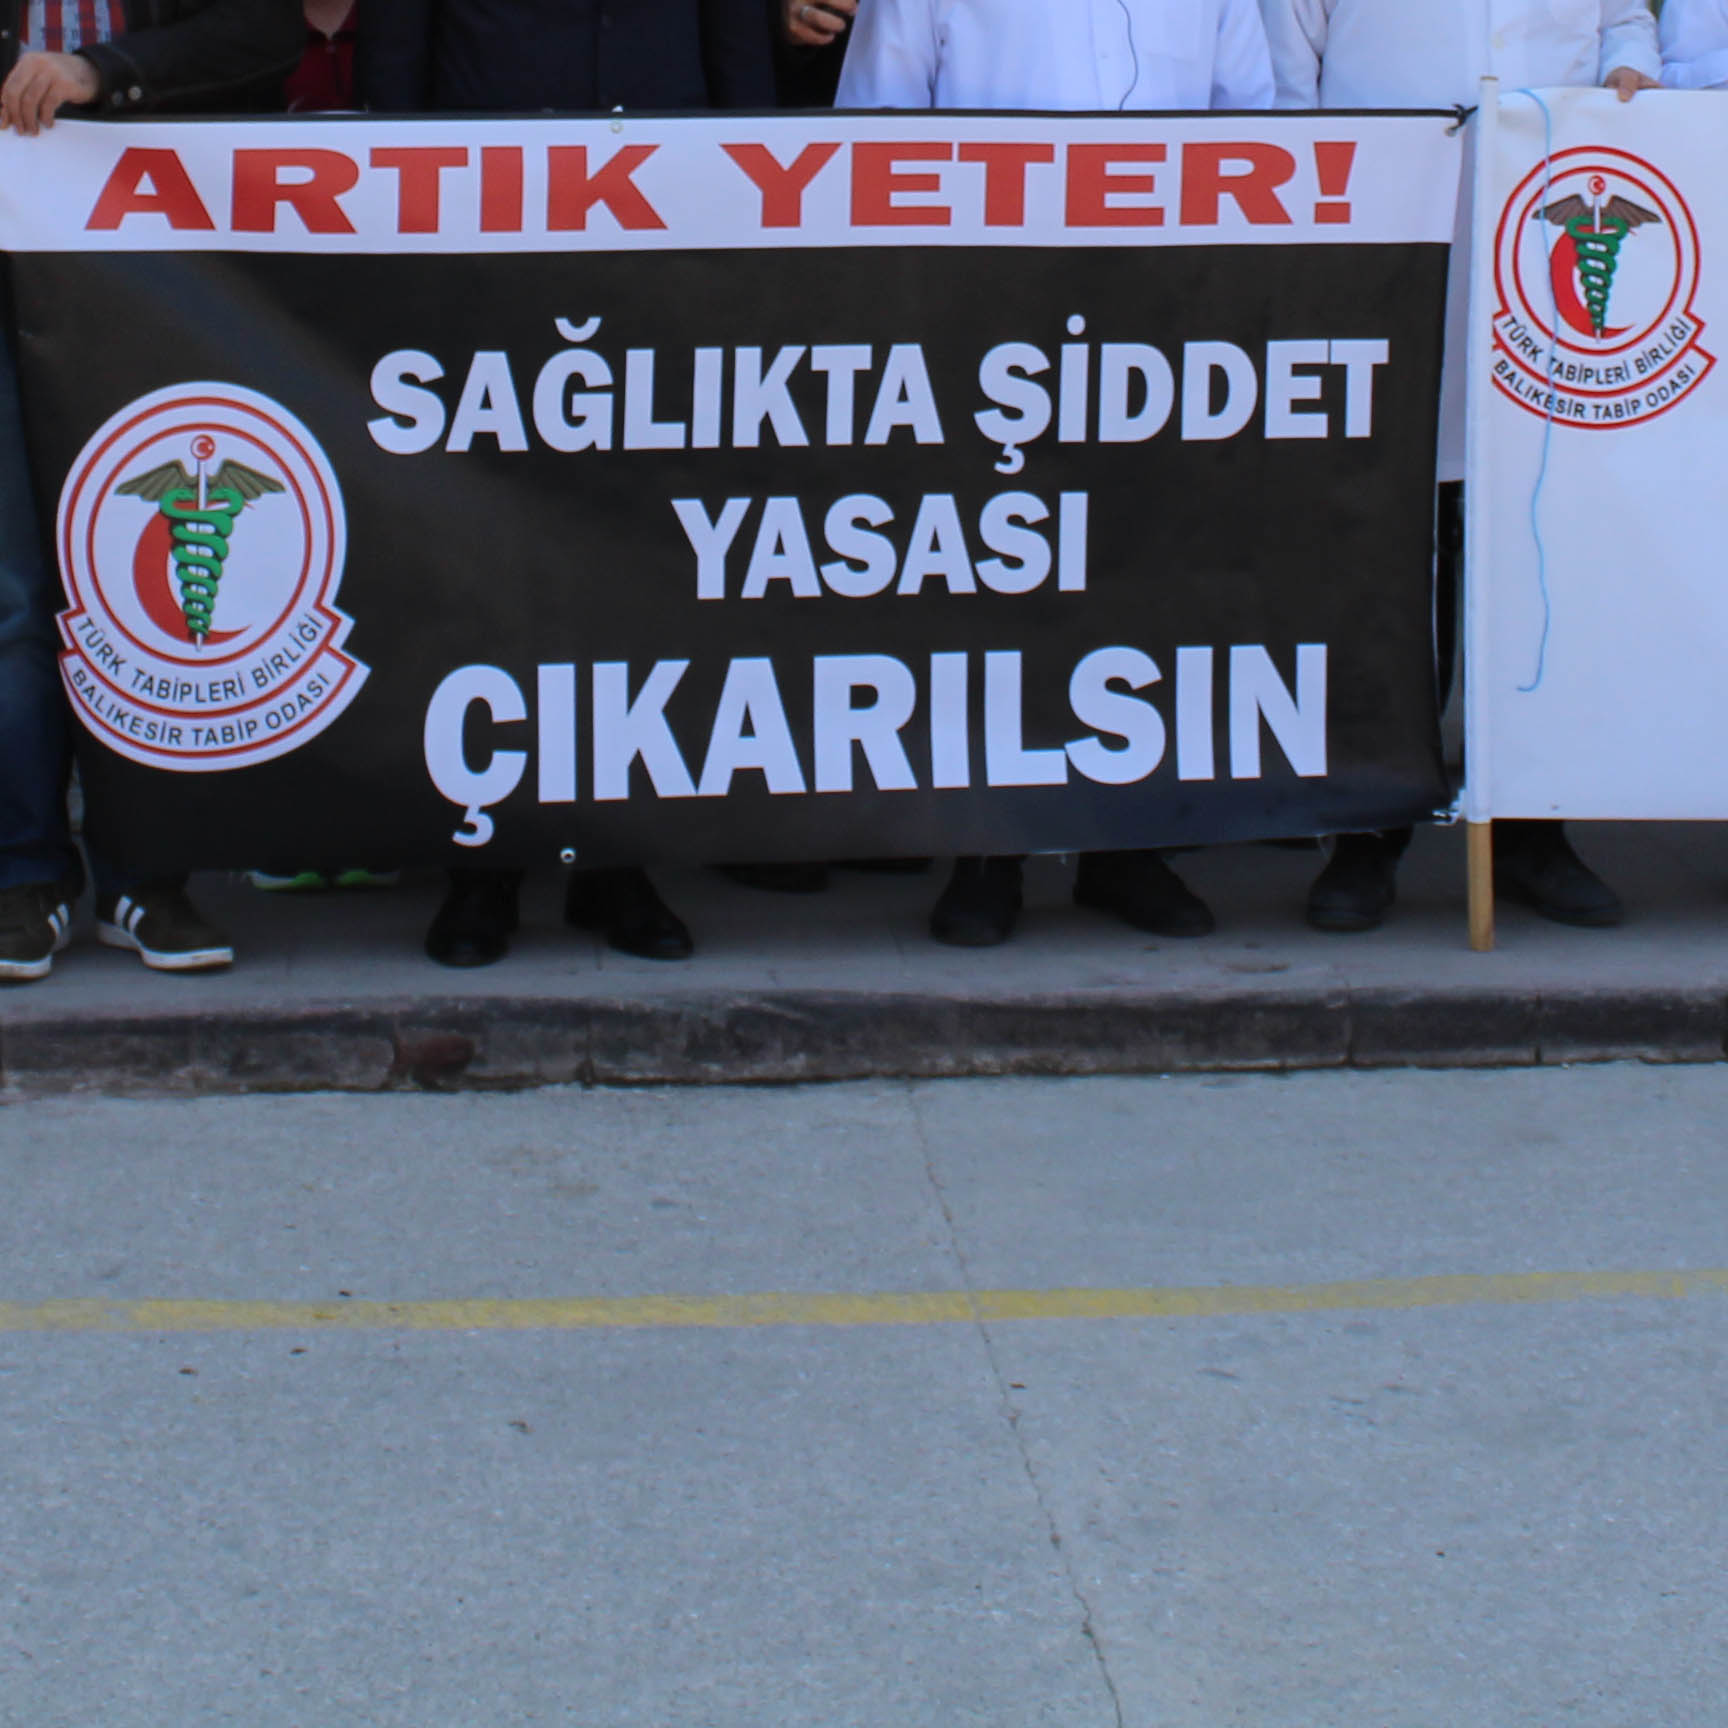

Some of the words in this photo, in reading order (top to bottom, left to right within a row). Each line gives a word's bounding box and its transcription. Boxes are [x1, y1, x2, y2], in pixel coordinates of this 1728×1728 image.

[88, 146, 665, 232] ARTIK
[723, 142, 1355, 227] YETER!
[368, 317, 944, 454] SAĞLIKTA
[974, 315, 1388, 473] ŞİDDET
[1493, 358, 1586, 419] BALIKESİR
[1593, 398, 1641, 421] TABİP
[1645, 363, 1696, 408] ODASI
[1501, 316, 1545, 363] TÜRK
[1548, 356, 1631, 386] TABİPLERİ
[1636, 316, 1691, 373] BİRLİĞİ
[672, 491, 1088, 599] YASASI
[76, 616, 132, 676] TÜRK
[130, 669, 245, 704] TABİPLERİ
[254, 612, 325, 689] BİRLİĞİ
[71, 668, 183, 747] BALIKESİR
[193, 718, 259, 748] TABİP
[265, 672, 331, 731] ODASI
[424, 643, 1327, 845] ÇIKARILSIN
